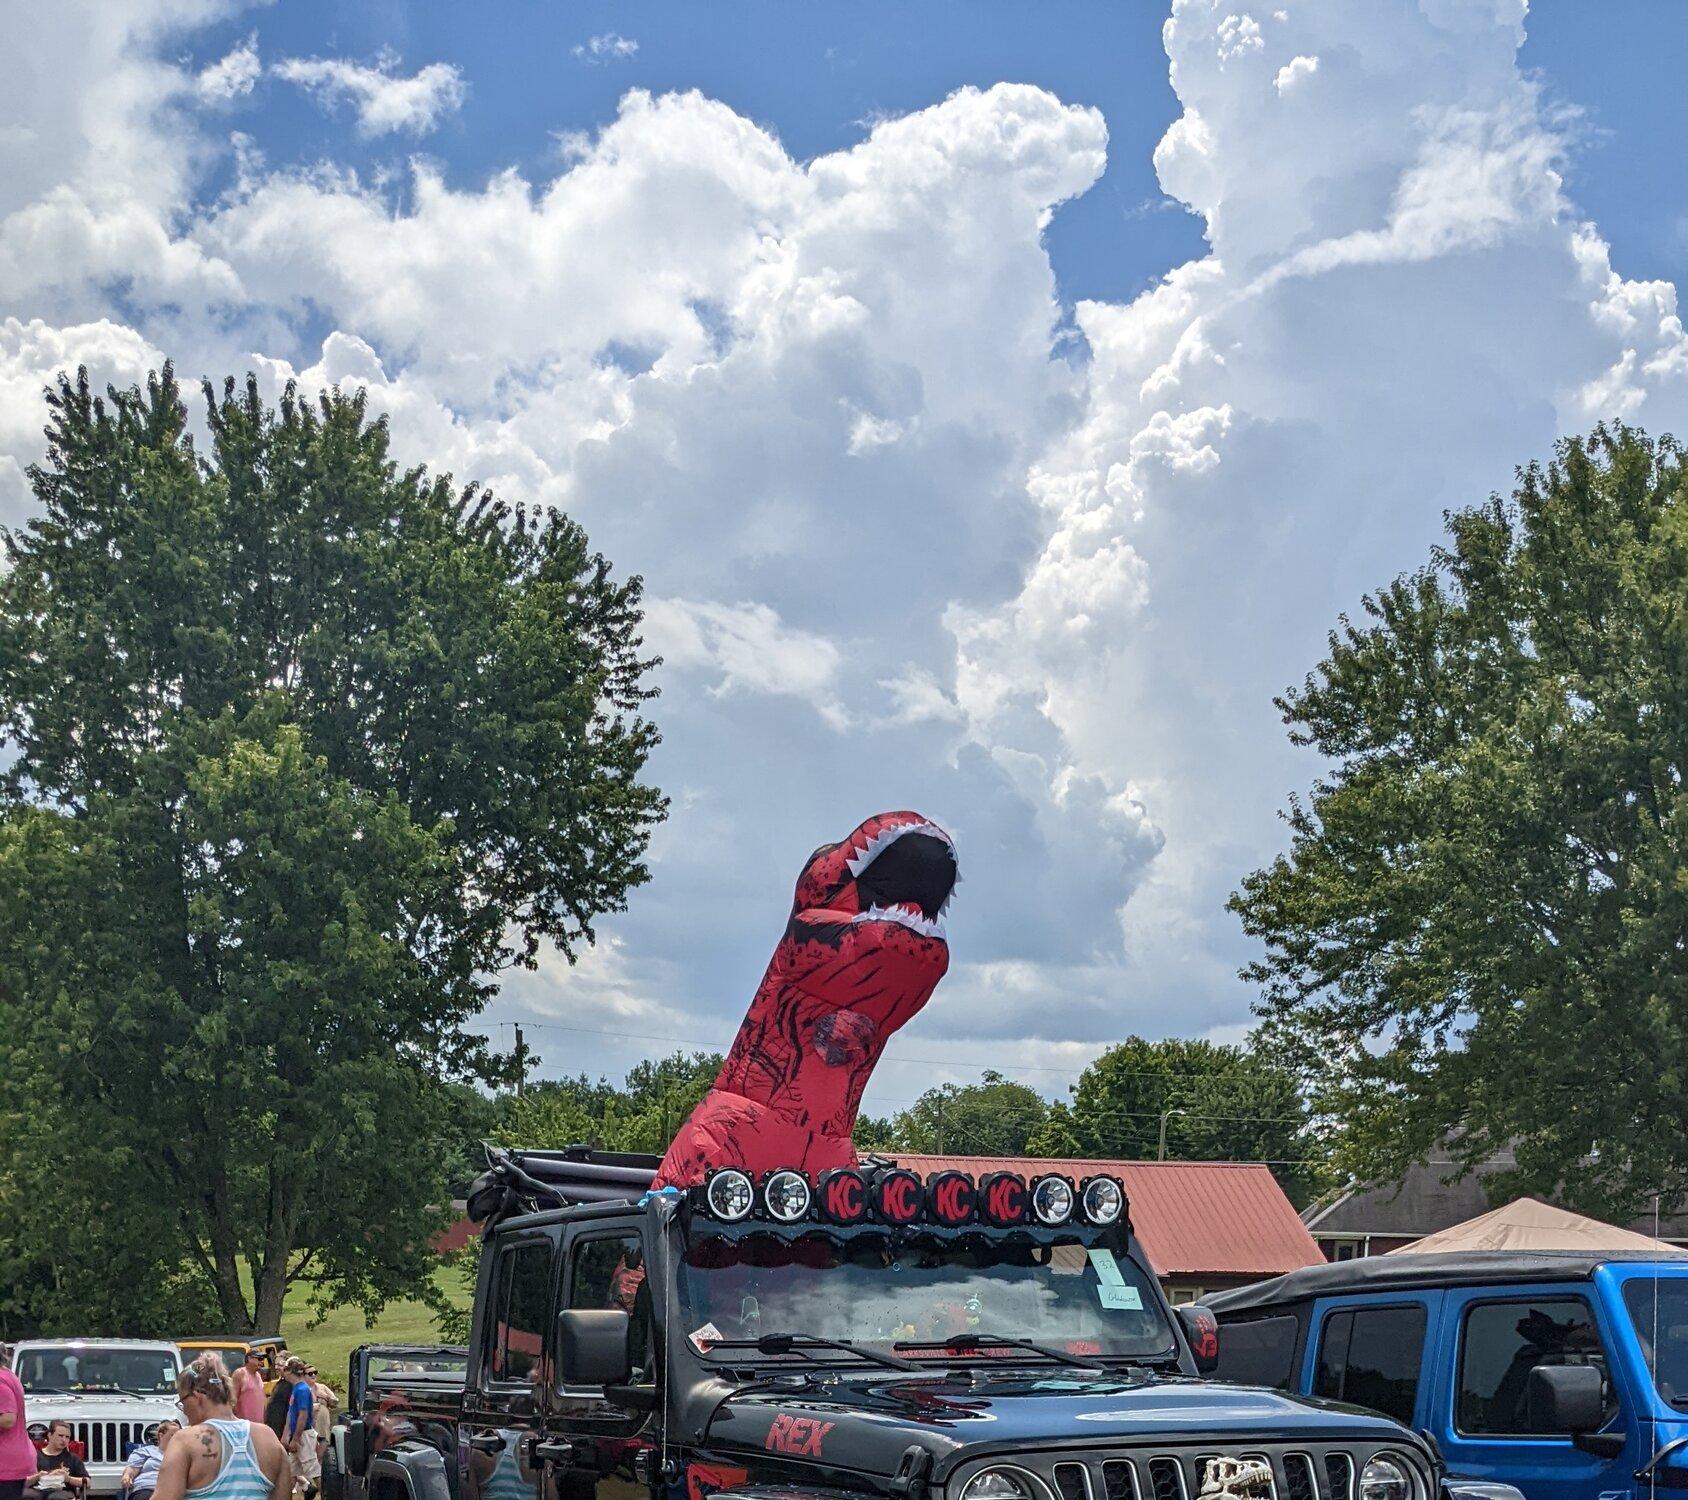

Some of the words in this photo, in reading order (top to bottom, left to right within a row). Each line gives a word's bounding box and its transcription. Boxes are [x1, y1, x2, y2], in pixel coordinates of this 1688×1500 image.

[827, 1175, 862, 1219] KC
[883, 1176, 917, 1220] KC
[937, 1177, 969, 1221] KC
[990, 1178, 1022, 1221] KC
[765, 1413, 836, 1457] REX
